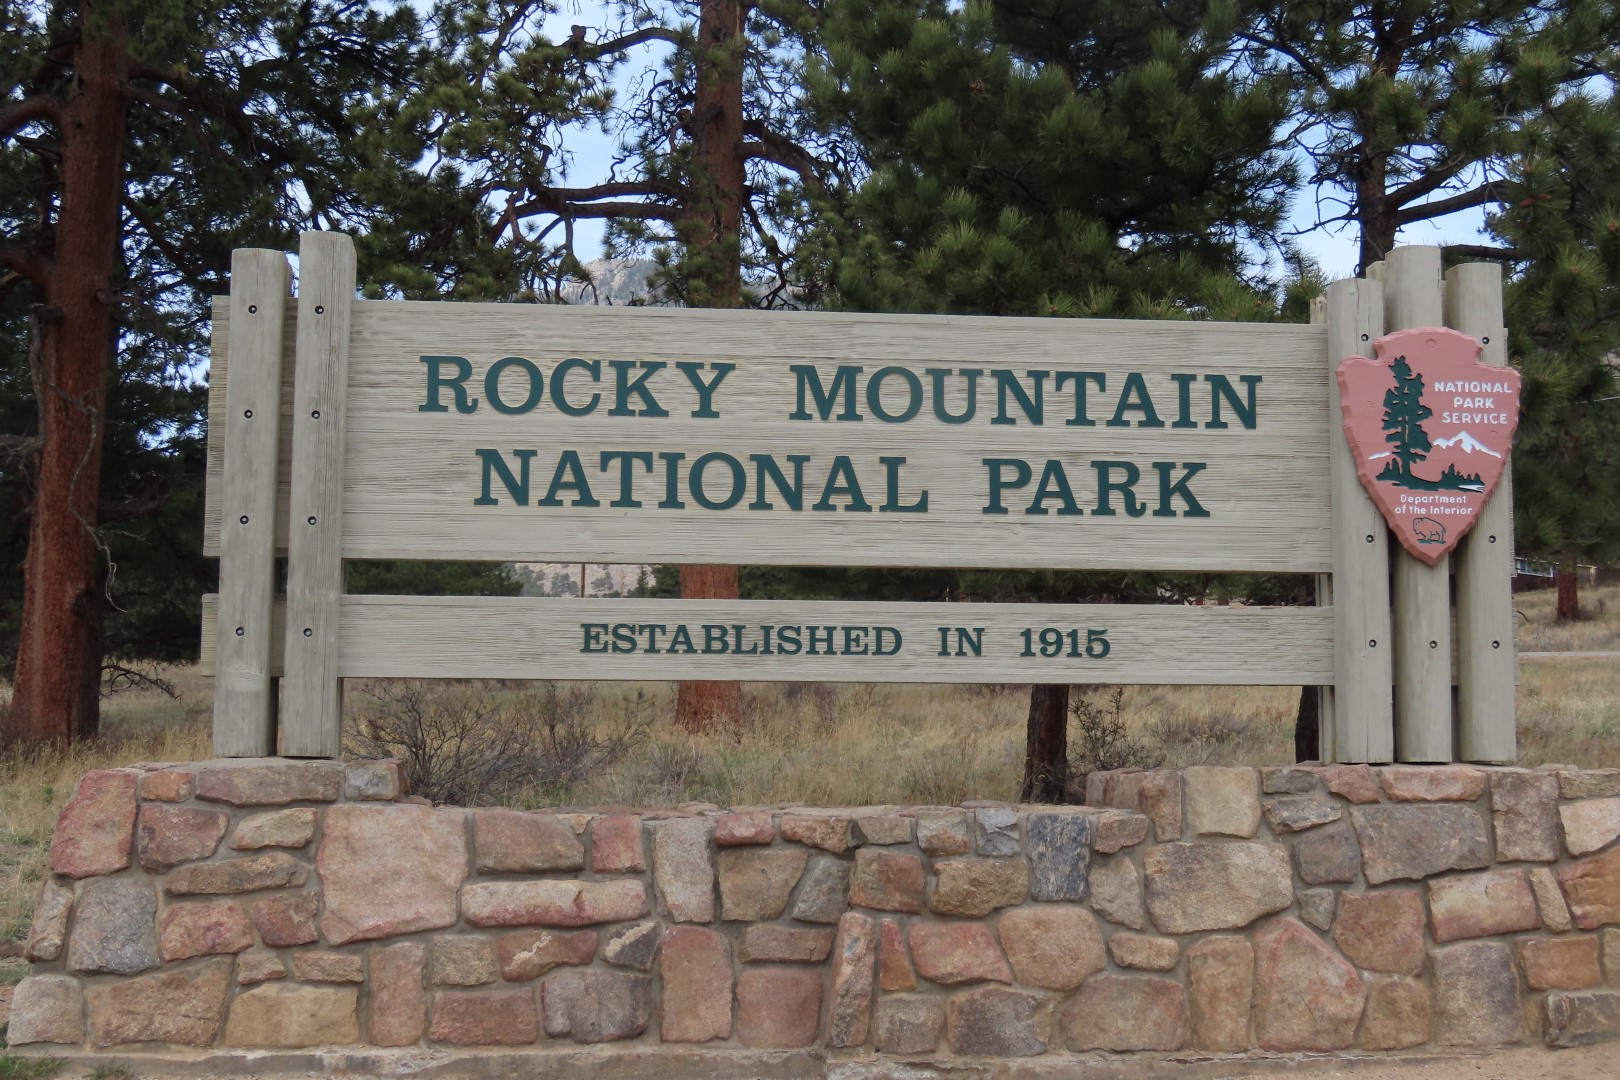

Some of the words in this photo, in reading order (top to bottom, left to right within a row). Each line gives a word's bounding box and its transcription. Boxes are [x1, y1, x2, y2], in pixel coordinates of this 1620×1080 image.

[418, 355, 736, 419] ROCKY
[789, 364, 1262, 430] MOUNTAIN
[1434, 381, 1512, 393] NATIONAL
[1453, 397, 1494, 409] PARK
[1442, 412, 1508, 425] SERVICE
[474, 448, 928, 512] NATIONAL
[982, 458, 1211, 518] PARK
[1400, 494, 1467, 505] Department
[1395, 505, 1406, 515] of
[1409, 505, 1427, 515] the
[1430, 505, 1473, 515] Interior
[579, 623, 903, 656] ESTABLISHED
[937, 626, 985, 657] IN
[1019, 628, 1111, 659] 1915
